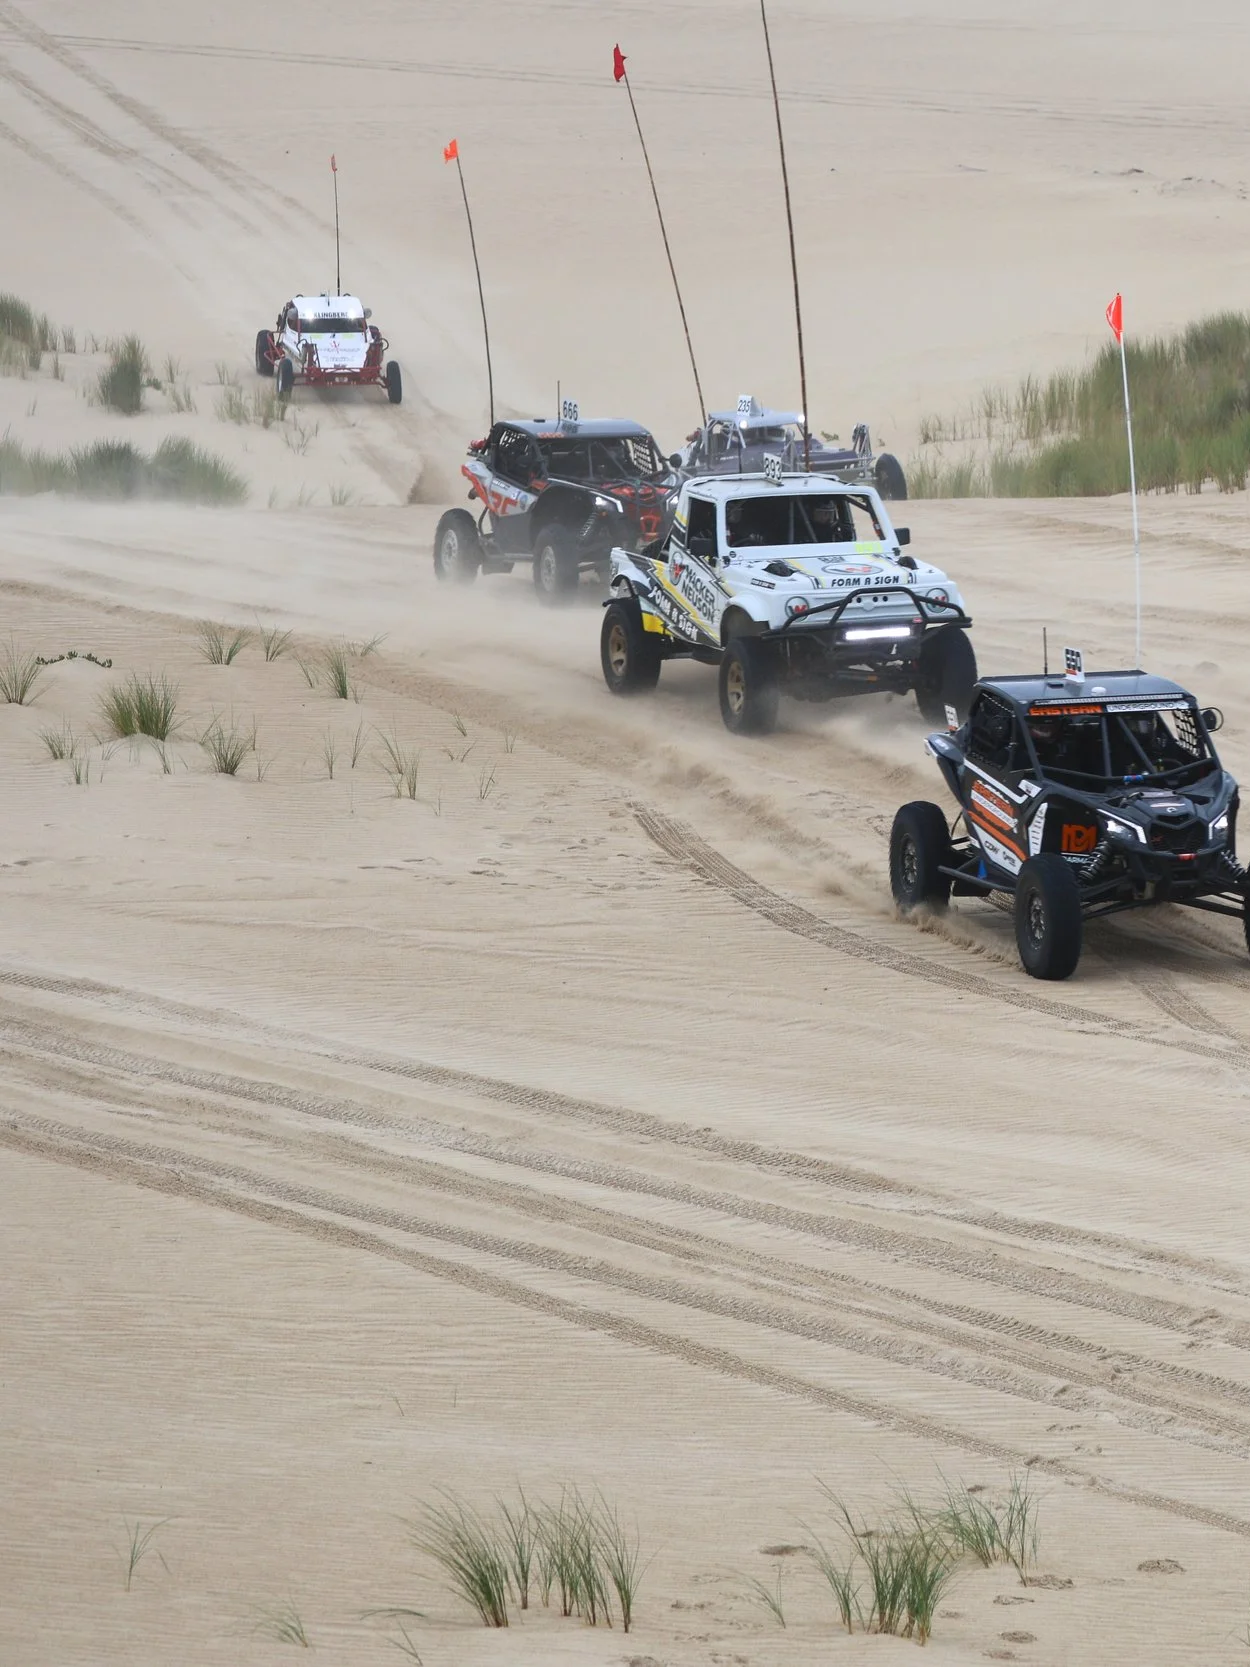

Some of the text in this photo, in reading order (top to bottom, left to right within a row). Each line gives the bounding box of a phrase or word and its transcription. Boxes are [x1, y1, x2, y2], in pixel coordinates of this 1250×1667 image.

[562, 400, 579, 421] 666
[737, 399, 751, 413] 235
[764, 457, 781, 481] 893
[685, 565, 716, 609] WACKER
[864, 577, 871, 586] A
[874, 575, 900, 585] SIGN
[681, 579, 715, 624] NEUSON
[678, 614, 698, 641] SIGN
[1029, 705, 1102, 716] EASTERN
[1107, 702, 1174, 713] UNDERGROUND
